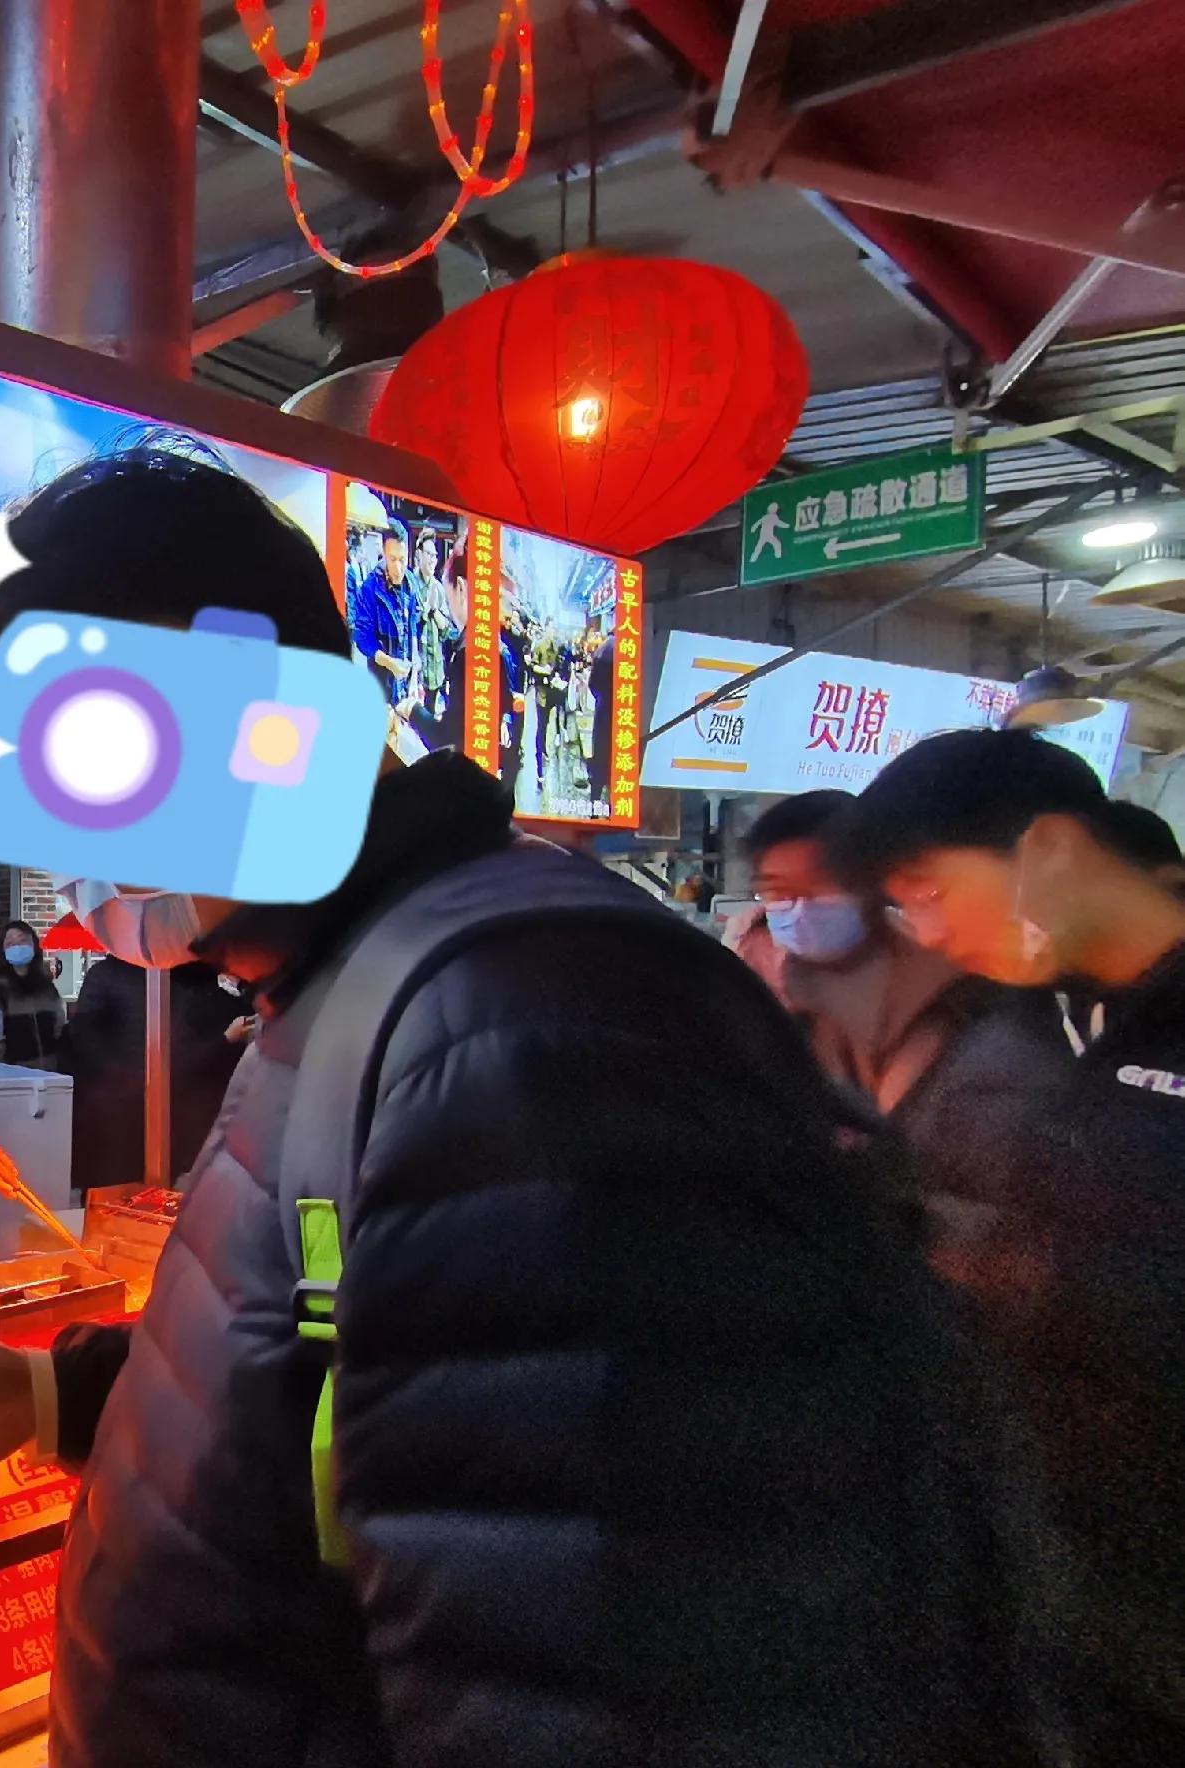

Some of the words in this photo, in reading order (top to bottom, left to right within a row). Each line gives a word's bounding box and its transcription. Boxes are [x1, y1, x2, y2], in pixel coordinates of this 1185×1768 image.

[794, 464, 968, 532] 应急疏散通道
